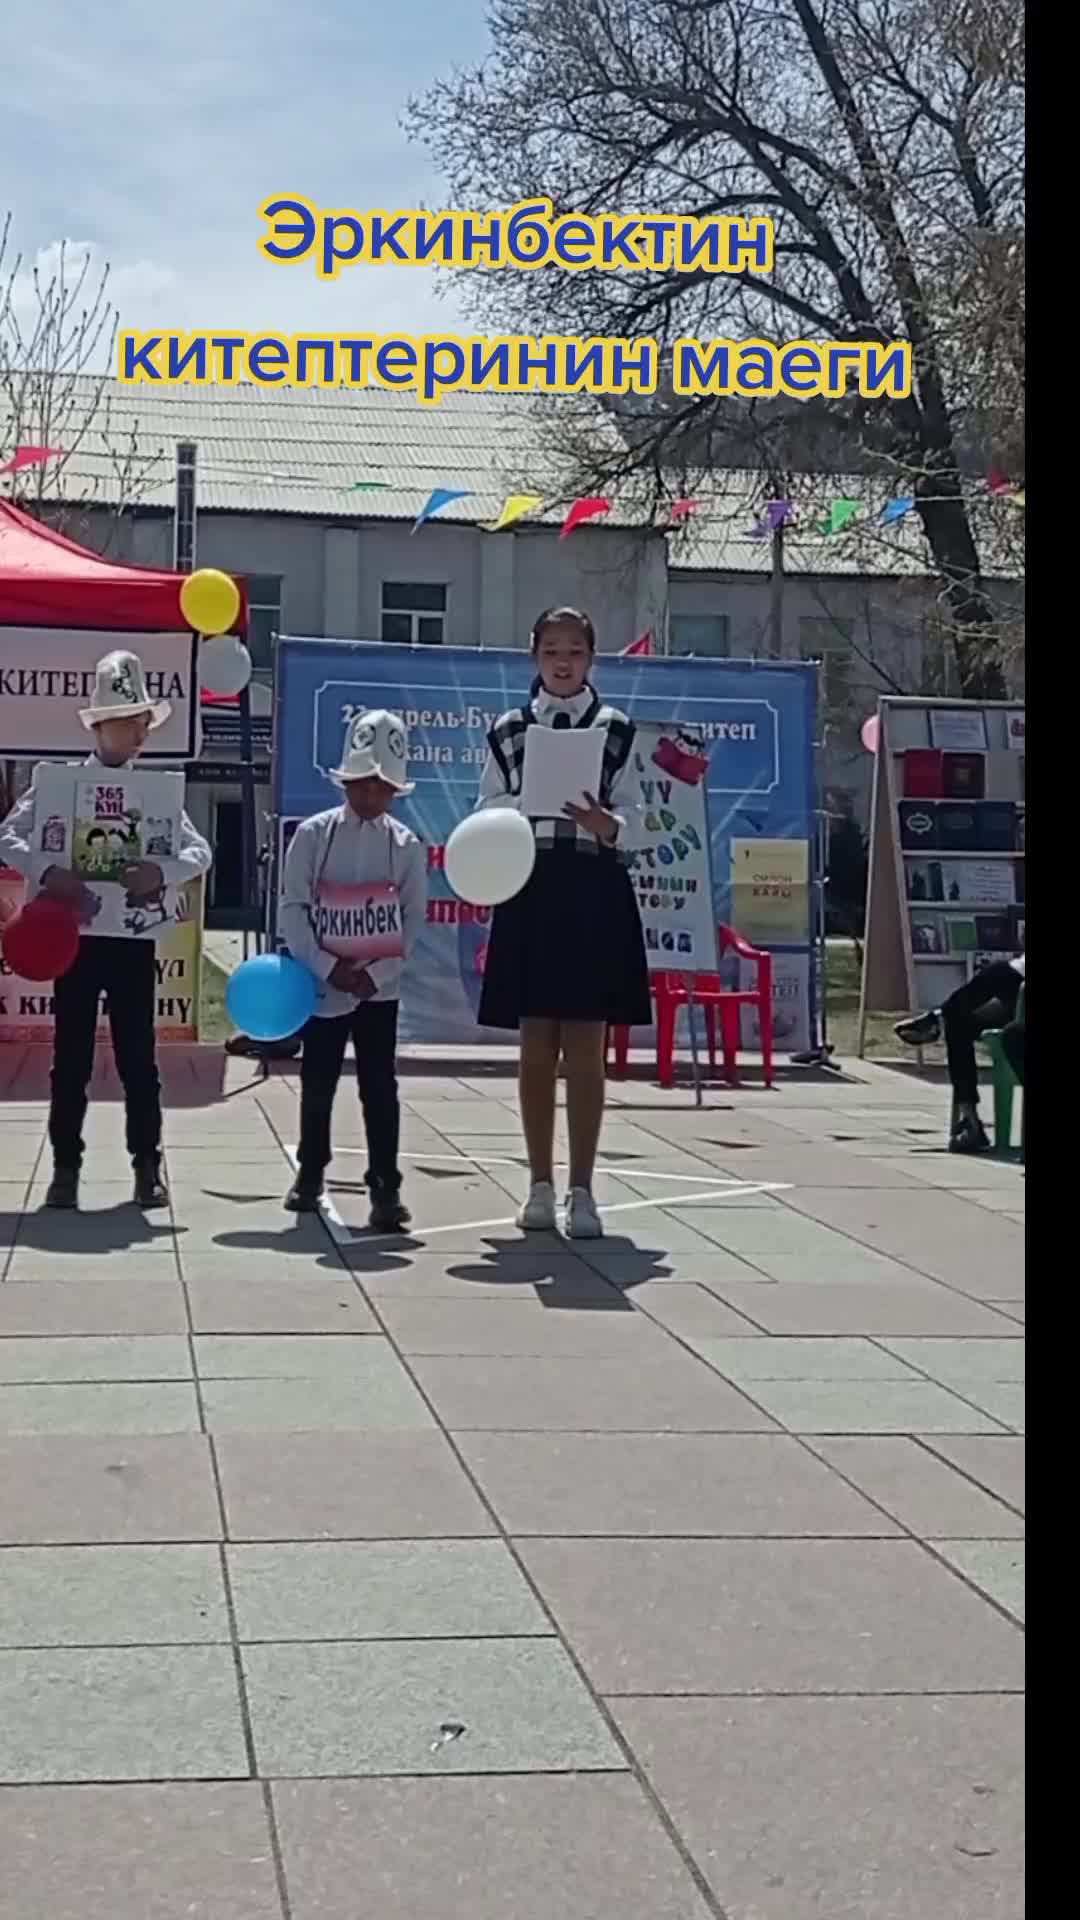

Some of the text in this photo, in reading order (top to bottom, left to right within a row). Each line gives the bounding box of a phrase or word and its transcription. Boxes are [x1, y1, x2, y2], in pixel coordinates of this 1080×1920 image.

[702, 722, 757, 741] итеп
[95, 786, 124, 801] 365
[314, 896, 406, 938] ркинбек
